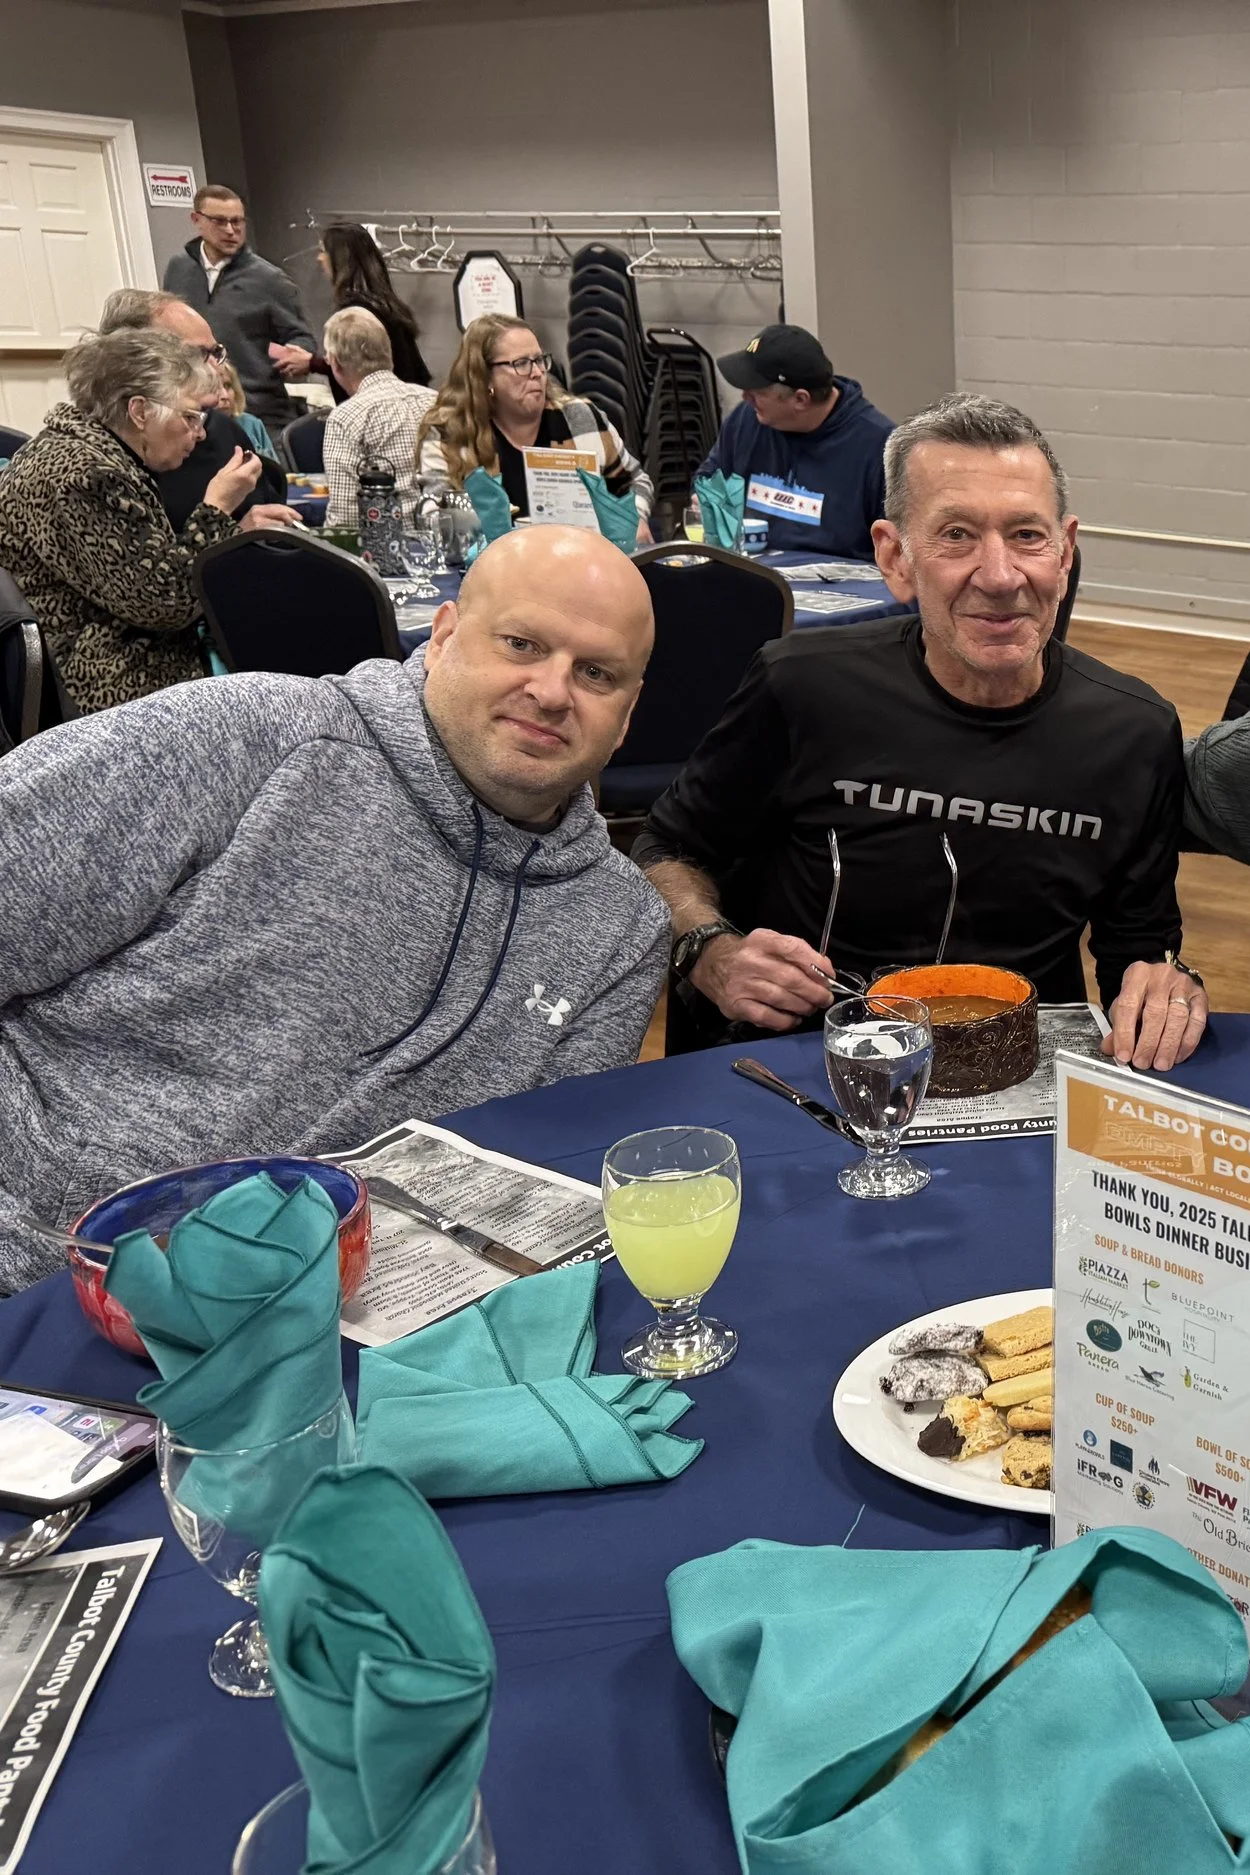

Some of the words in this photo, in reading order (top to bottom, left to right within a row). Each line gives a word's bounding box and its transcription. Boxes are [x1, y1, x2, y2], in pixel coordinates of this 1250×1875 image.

[151, 184, 192, 198] RESTROOMS
[832, 779, 1103, 841] TUNASKIN
[980, 1121, 1018, 1134] Food
[1022, 1119, 1057, 1132] unty
[1103, 1094, 1205, 1139] TALBOT
[908, 1124, 976, 1139] Pantries
[1092, 1169, 1137, 1203] THANK
[1141, 1187, 1174, 1218] YOU,
[1178, 1201, 1217, 1229] 2025
[1209, 1185, 1224, 1195] ACT
[1105, 1201, 1151, 1234] BOWLS
[1156, 1221, 1210, 1256] DINNER
[1087, 1258, 1129, 1284] PIAZZA
[1094, 1233, 1119, 1253] SOUP
[1121, 1243, 1129, 1256] &
[1130, 1247, 1162, 1270] BREAD
[1164, 1259, 1205, 1286] DONORS
[1170, 1292, 1237, 1323] BLUEPOINT
[1076, 1341, 1120, 1370] Panera
[1193, 1373, 1220, 1389] Garden
[1193, 1383, 1223, 1400] Garnish
[1095, 1392, 1114, 1409] CUP
[1116, 1401, 1128, 1415] OF
[1130, 1407, 1155, 1426] SOUP
[1110, 1415, 1138, 1435] $250+
[1196, 1435, 1223, 1458] BOWL
[1225, 1449, 1238, 1463] OF
[1215, 1462, 1245, 1483] $500+
[1191, 1477, 1238, 1512] VFW
[1203, 1518, 1224, 1541] Old
[1188, 1547, 1217, 1570] THER
[78, 1564, 126, 1628] Talbot
[36, 1629, 96, 1696] County
[12, 1698, 60, 1752] Food
